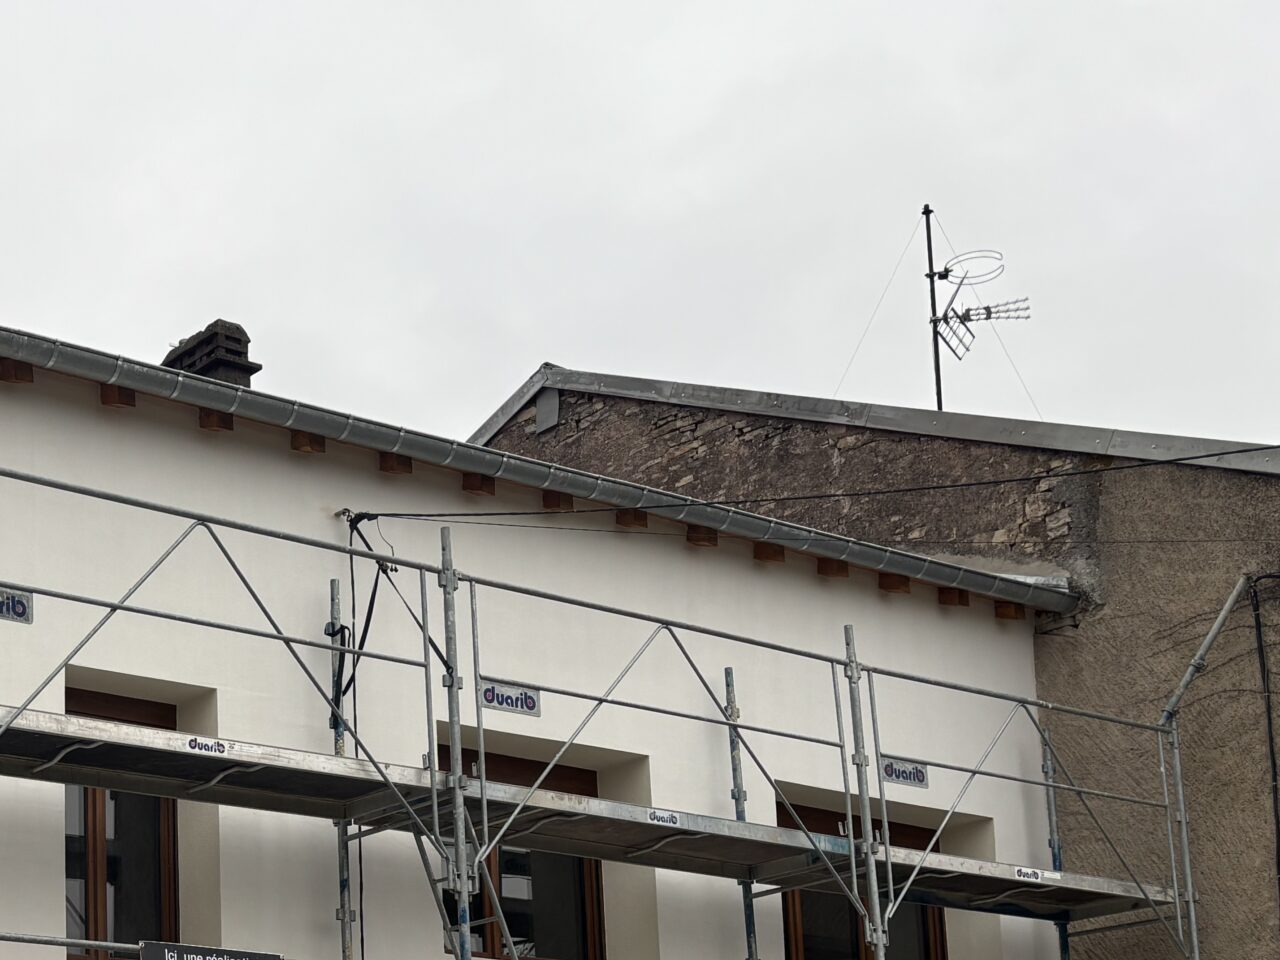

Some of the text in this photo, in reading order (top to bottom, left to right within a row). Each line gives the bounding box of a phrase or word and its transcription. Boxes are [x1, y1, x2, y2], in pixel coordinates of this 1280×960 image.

[484, 686, 536, 712] duarib
[188, 738, 225, 753] duarib
[885, 763, 925, 782] duarib
[649, 811, 677, 824] duarib
[1017, 869, 1039, 879] duarib
